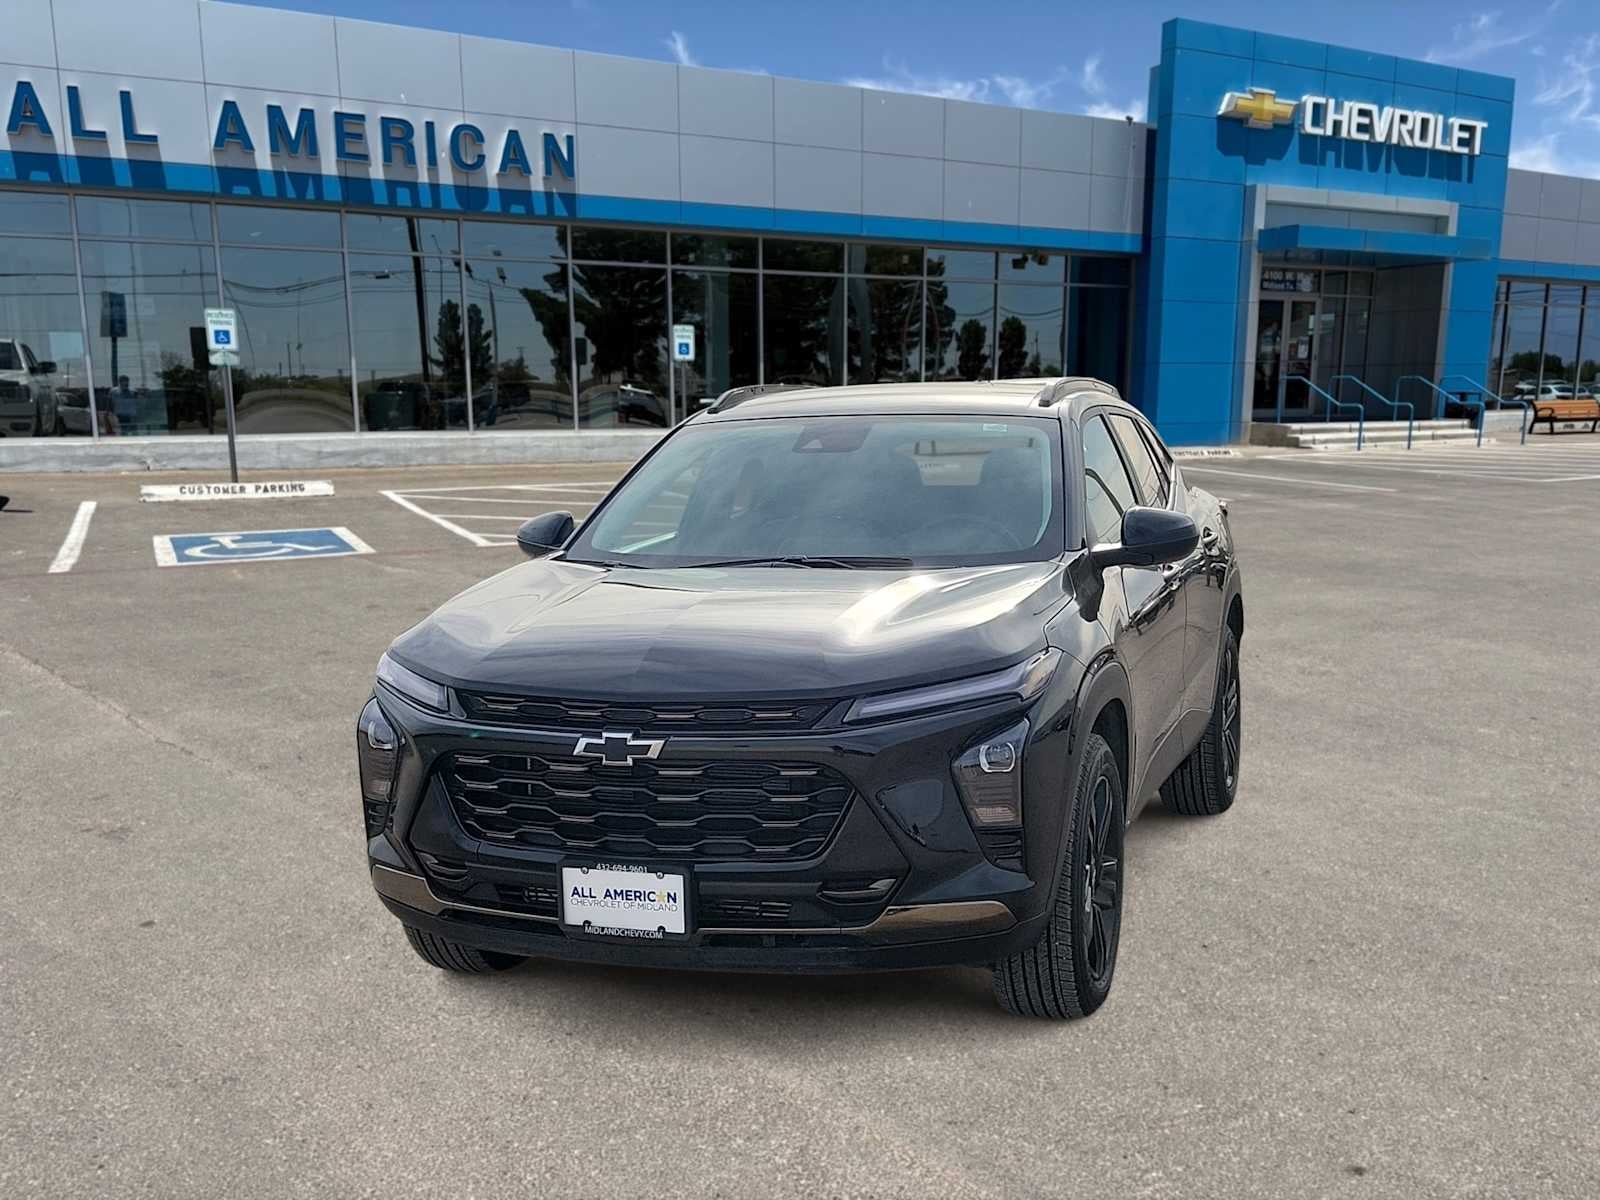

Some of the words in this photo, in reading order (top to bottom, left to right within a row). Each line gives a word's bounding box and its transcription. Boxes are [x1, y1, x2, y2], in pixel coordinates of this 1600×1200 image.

[6, 80, 159, 144] ALL
[213, 99, 576, 180] AMERICAN
[1301, 95, 1488, 155] CHEVROLET
[179, 484, 246, 496] CUSTOMER
[255, 483, 305, 493] PARKING
[571, 886, 597, 898] ALL
[604, 888, 677, 903] AMERICN
[570, 899, 621, 909] CHEVROLET
[623, 901, 636, 909] OF
[637, 903, 678, 912] MIDLAND
[584, 926, 663, 939] MIDLANDCHEVY.COM
